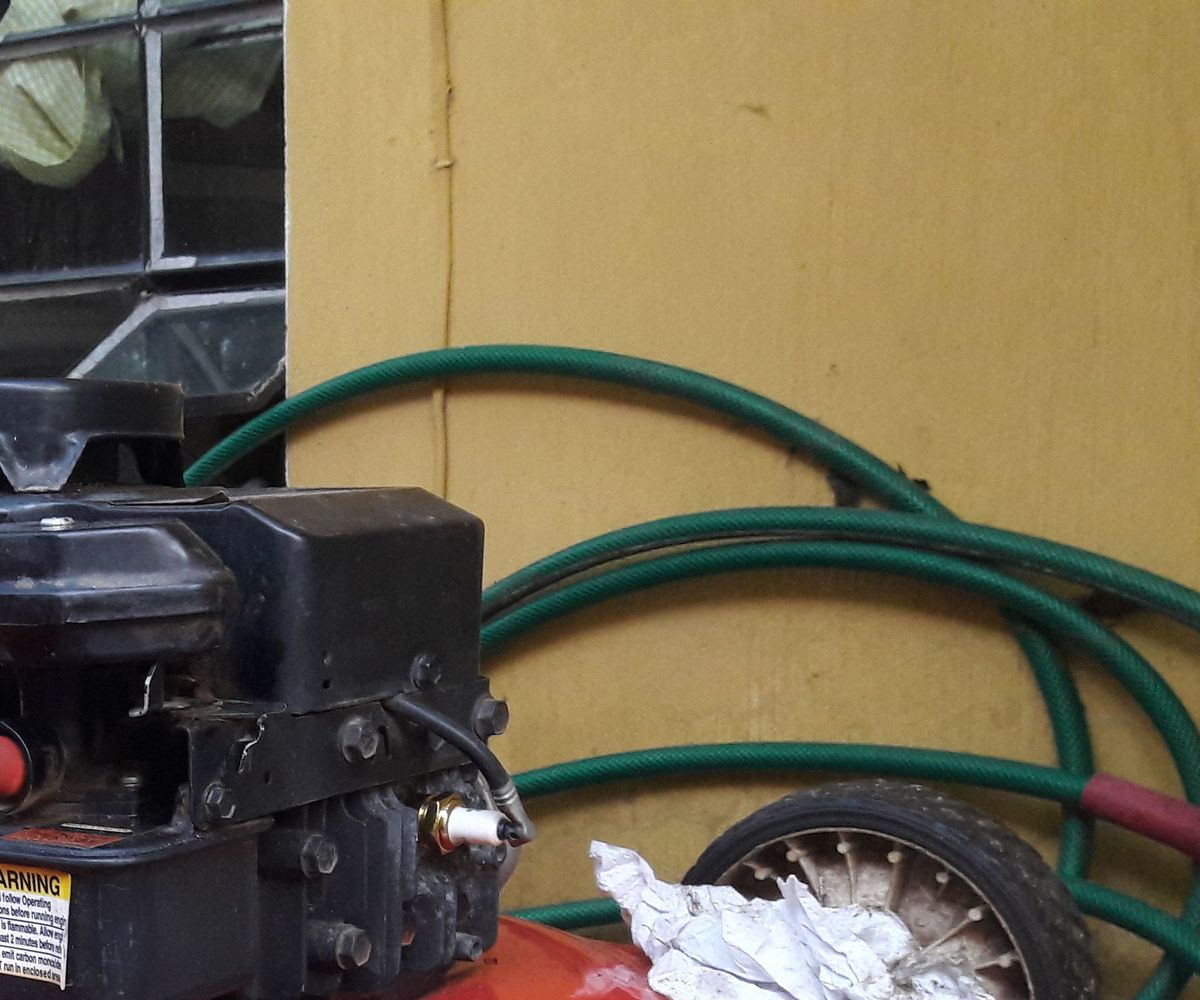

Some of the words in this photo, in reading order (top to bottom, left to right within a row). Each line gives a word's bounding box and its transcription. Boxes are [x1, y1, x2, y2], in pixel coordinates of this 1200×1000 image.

[3, 892, 20, 904] follow
[22, 895, 51, 912] Operating
[11, 906, 30, 919] before
[31, 911, 53, 925] running
[1, 919, 6, 930] is
[7, 920, 38, 935] flammable.
[40, 926, 54, 939] Allow
[15, 935, 38, 949] minutes
[2, 950, 14, 960] emit
[16, 952, 36, 964] carbon
[4, 962, 14, 972] run
[15, 961, 21, 973] in
[23, 965, 51, 980] enclosed
